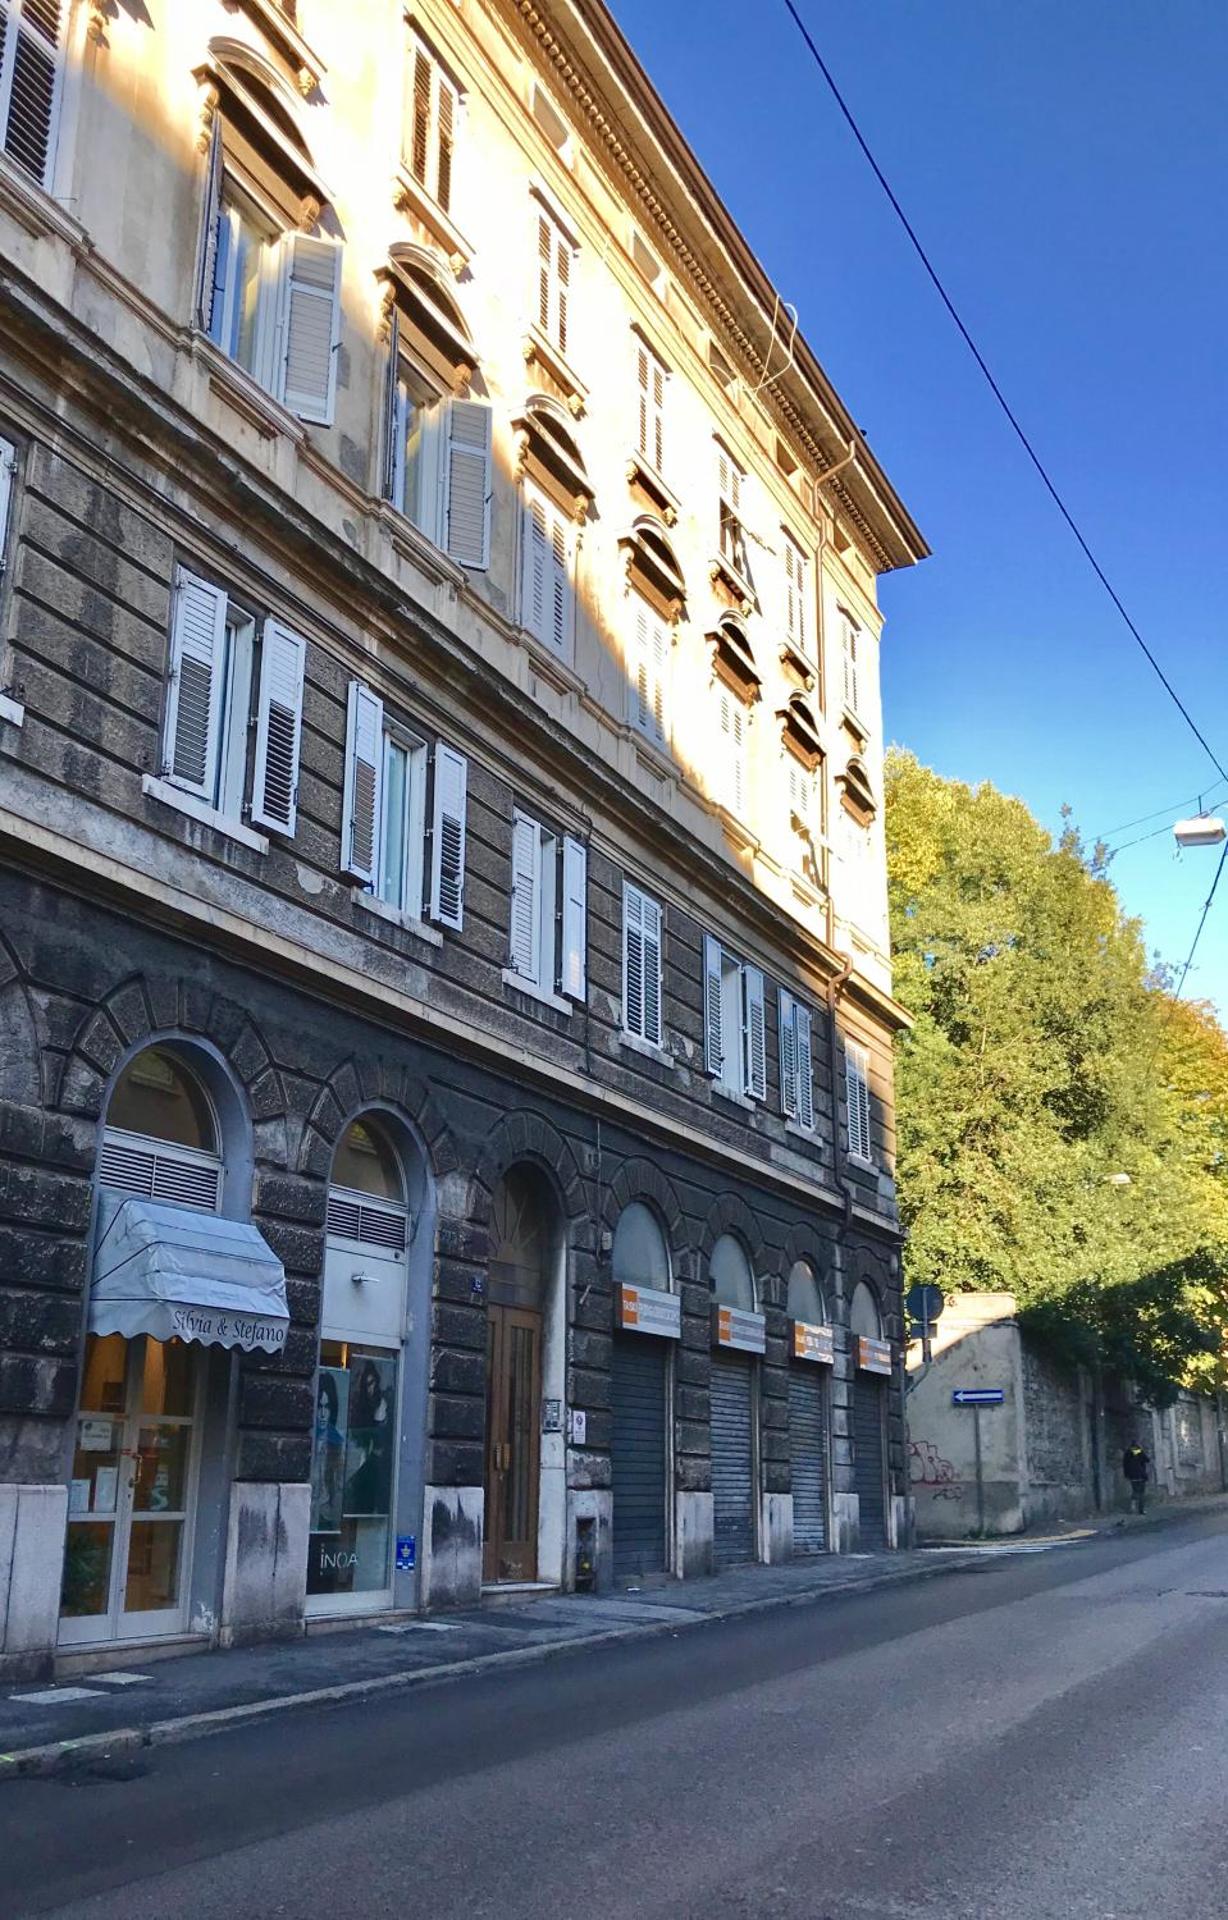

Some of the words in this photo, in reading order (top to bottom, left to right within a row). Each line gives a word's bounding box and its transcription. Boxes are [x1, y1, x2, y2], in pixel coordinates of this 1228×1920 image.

[172, 1310, 212, 1334] Silvia
[217, 1318, 228, 1336] &
[233, 1320, 284, 1346] Stefano
